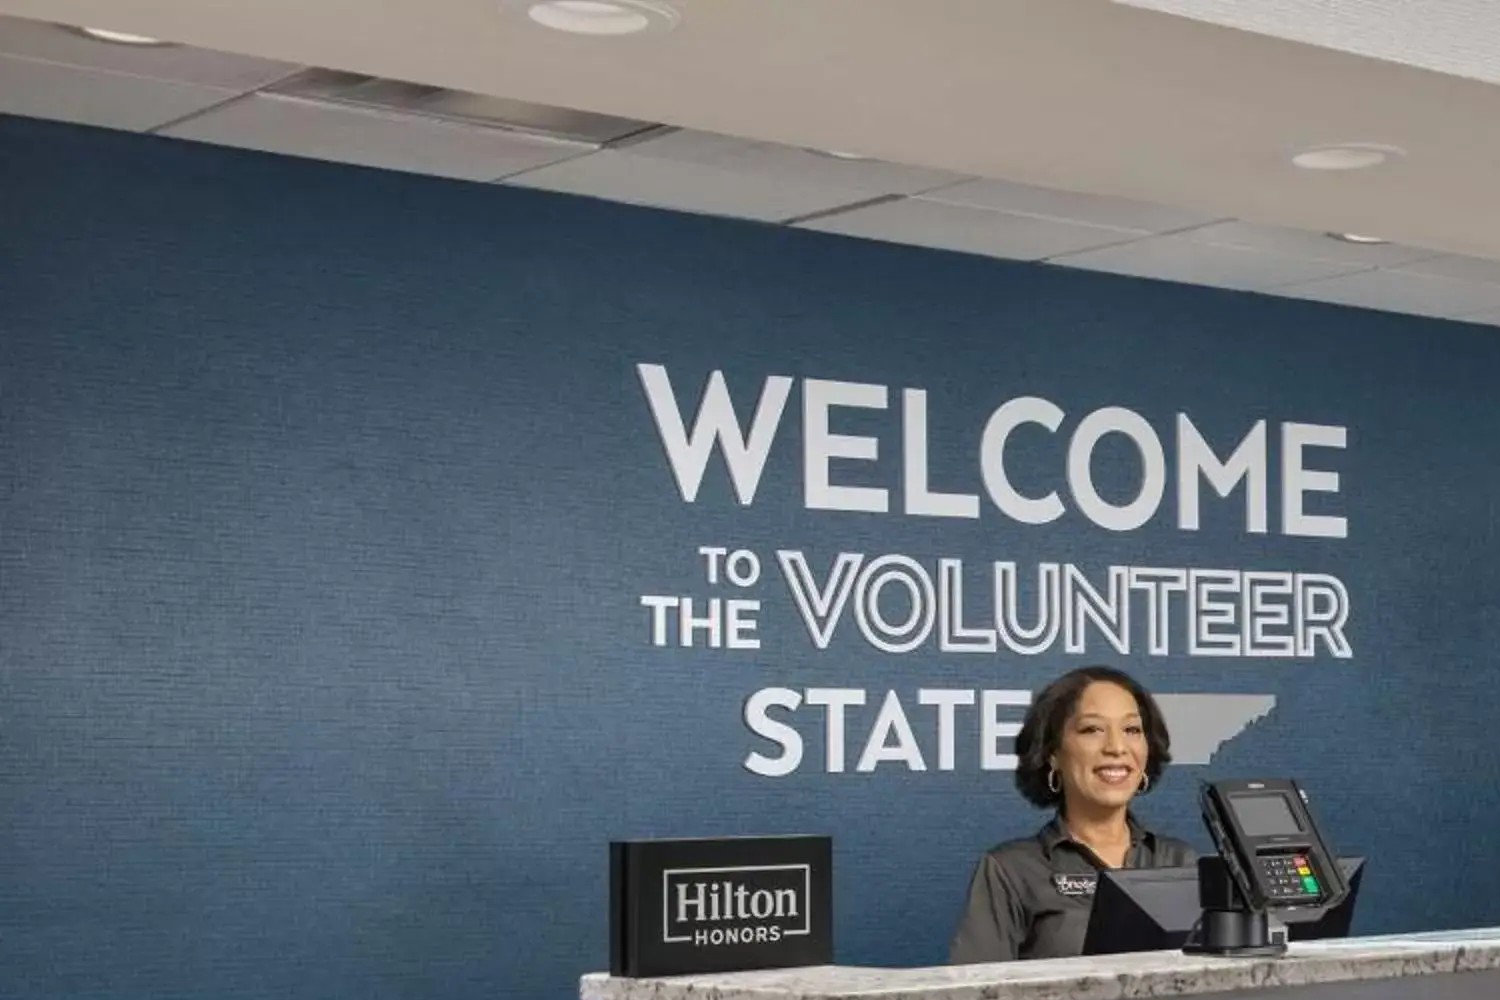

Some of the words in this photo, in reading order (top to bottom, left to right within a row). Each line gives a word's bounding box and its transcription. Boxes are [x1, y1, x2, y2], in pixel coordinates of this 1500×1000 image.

[636, 363, 1348, 538] WELCOME
[698, 546, 761, 588] TO
[640, 594, 761, 650] THE
[776, 549, 1353, 659] VOLUNTEER
[743, 687, 1034, 777] STATE
[676, 881, 799, 922] Hilton
[695, 925, 782, 946] HONORS
